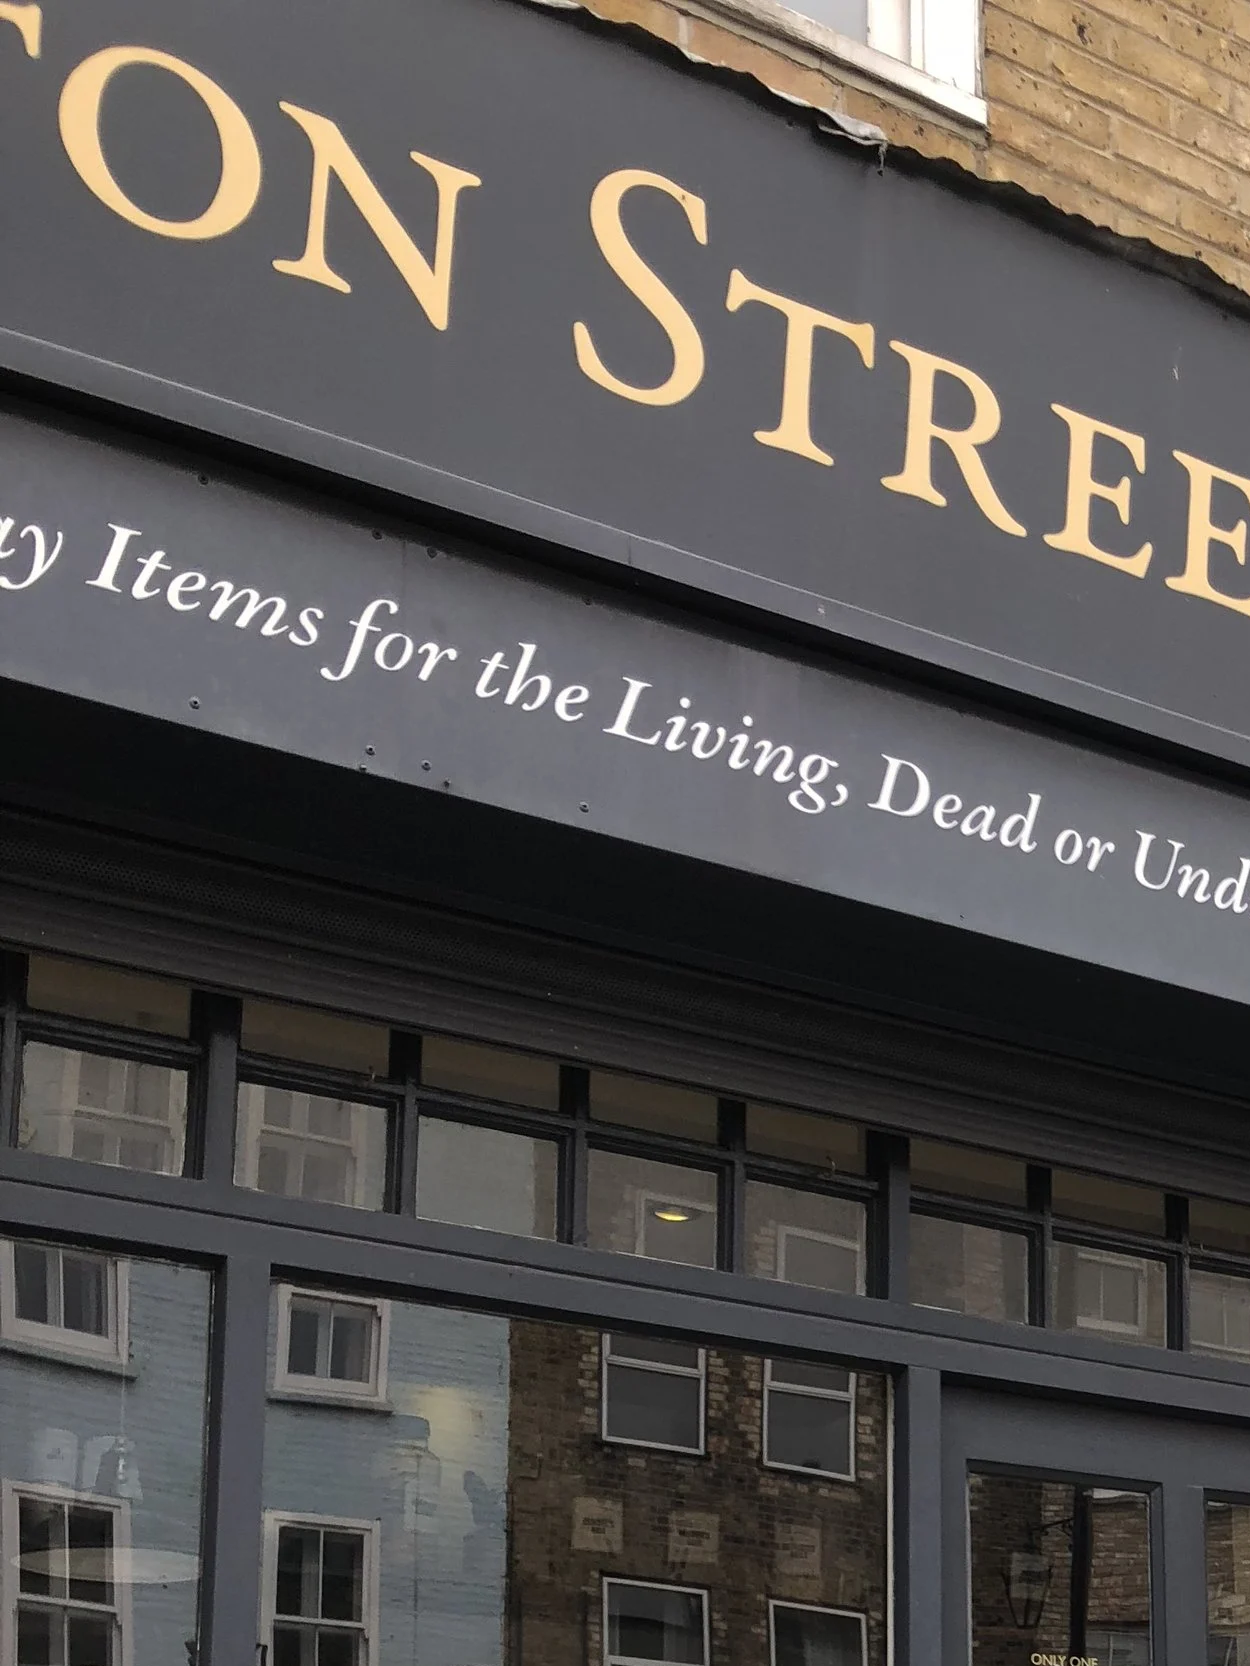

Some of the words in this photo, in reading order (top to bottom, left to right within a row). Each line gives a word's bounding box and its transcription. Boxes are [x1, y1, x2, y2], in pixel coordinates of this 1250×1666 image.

[85, 522, 325, 646] Items
[320, 598, 457, 681] for
[474, 642, 590, 722] the
[602, 677, 848, 814] Living,
[867, 753, 1042, 853] Dead
[1053, 827, 1115, 872] or
[1031, 1653, 1066, 1666] ONLY
